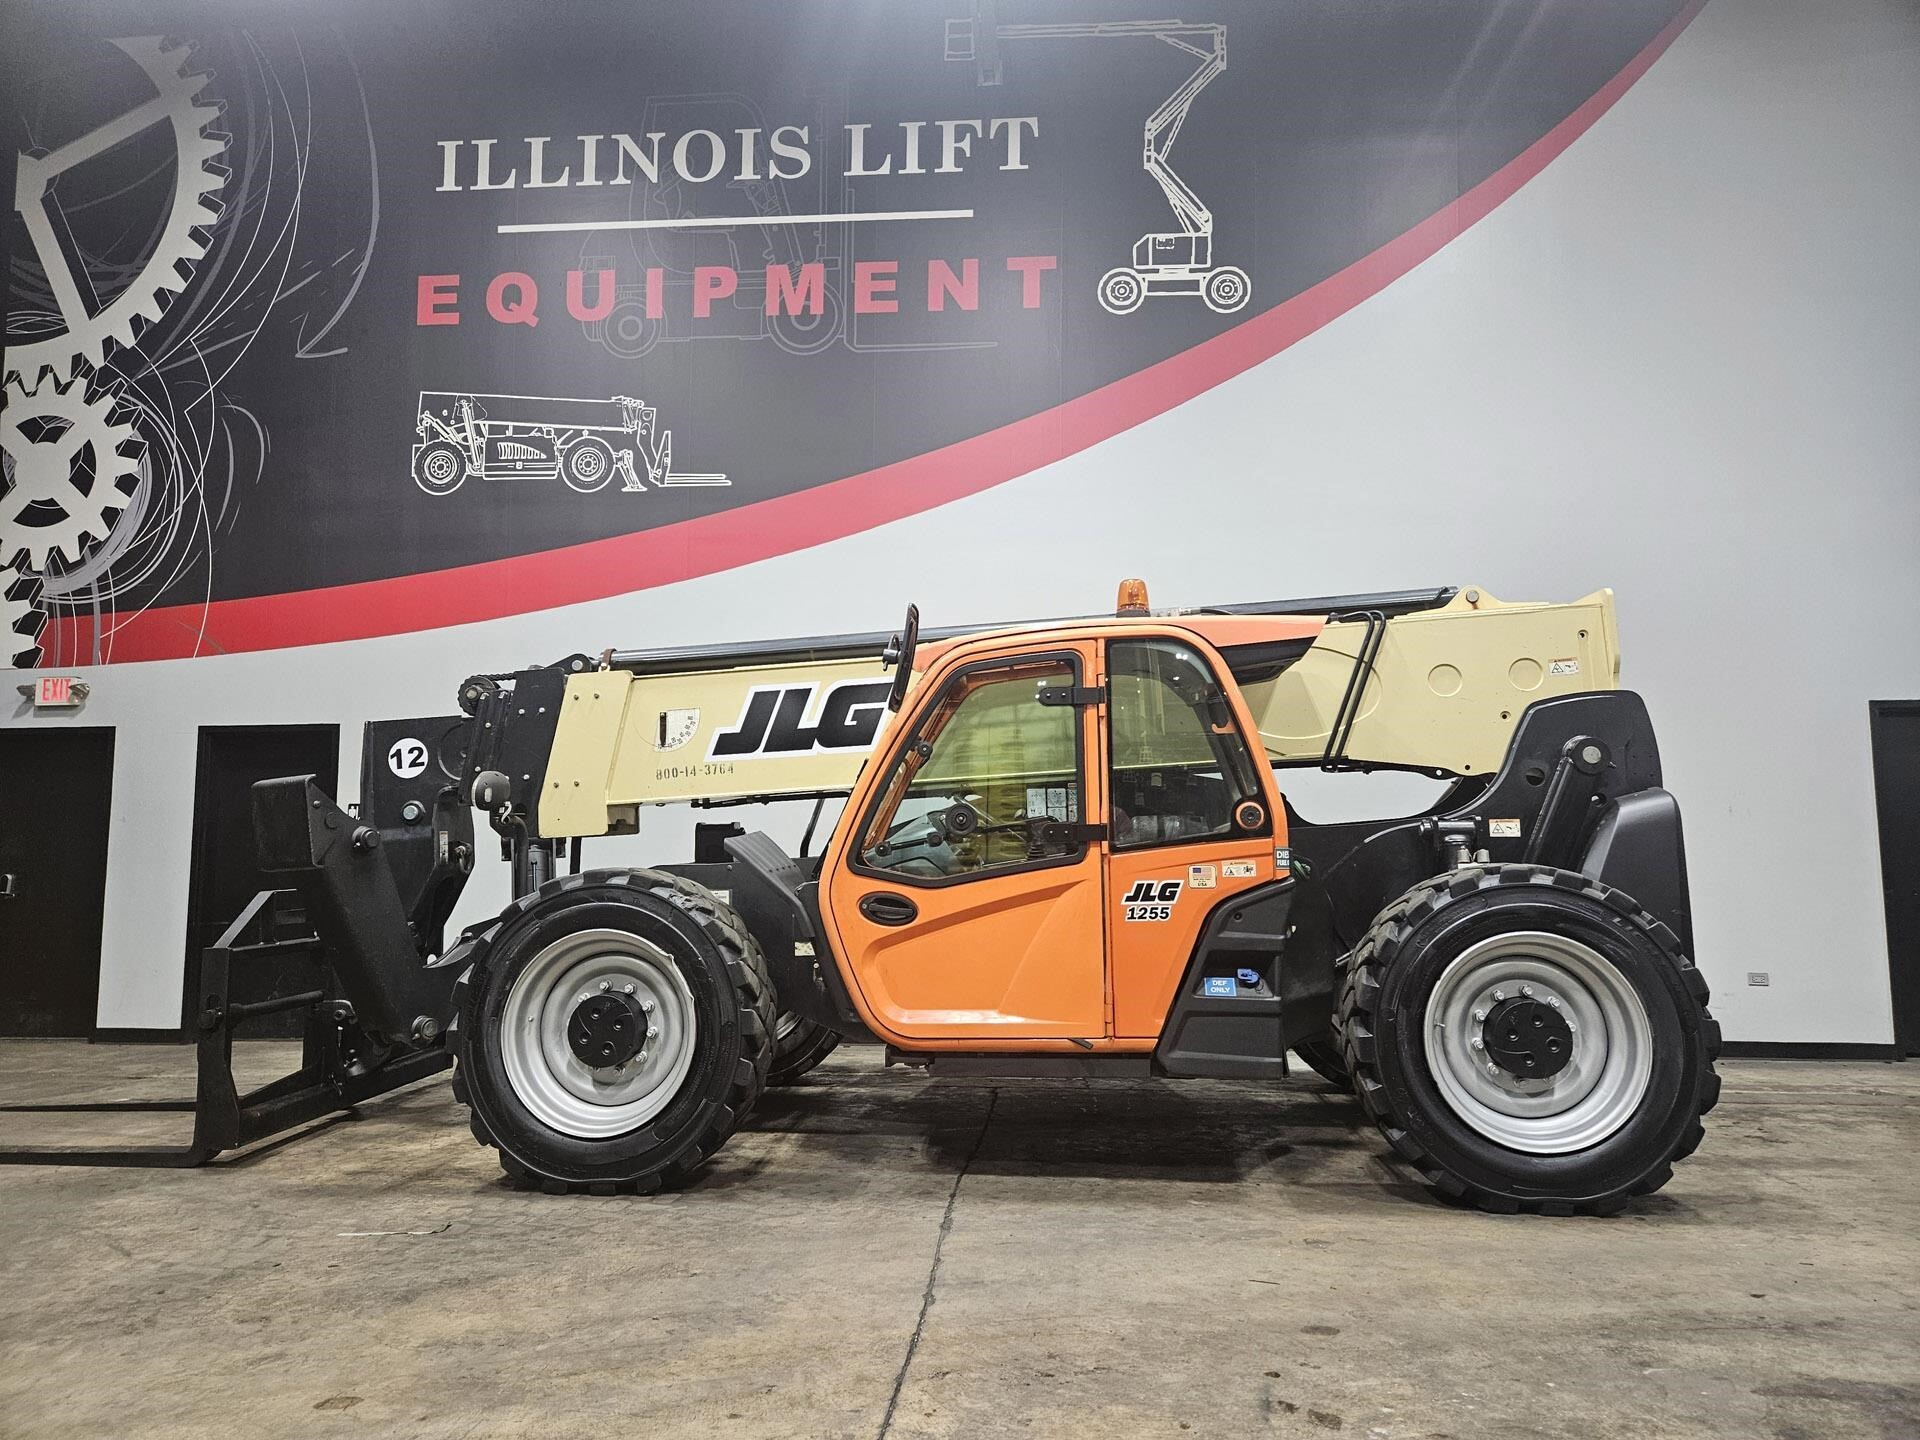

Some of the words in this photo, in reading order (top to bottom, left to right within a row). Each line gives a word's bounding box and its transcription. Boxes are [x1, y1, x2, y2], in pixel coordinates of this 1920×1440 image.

[436, 126, 812, 192] ILLINOIS
[843, 117, 1040, 176] LIFT
[416, 256, 1057, 327] EQUIPMENT
[43, 678, 71, 703] EXIT
[712, 682, 894, 756] JLG
[389, 746, 425, 770] 12
[655, 763, 734, 781] 800-14-3764
[1124, 882, 1182, 903] JLG
[1126, 907, 1170, 920] 1255
